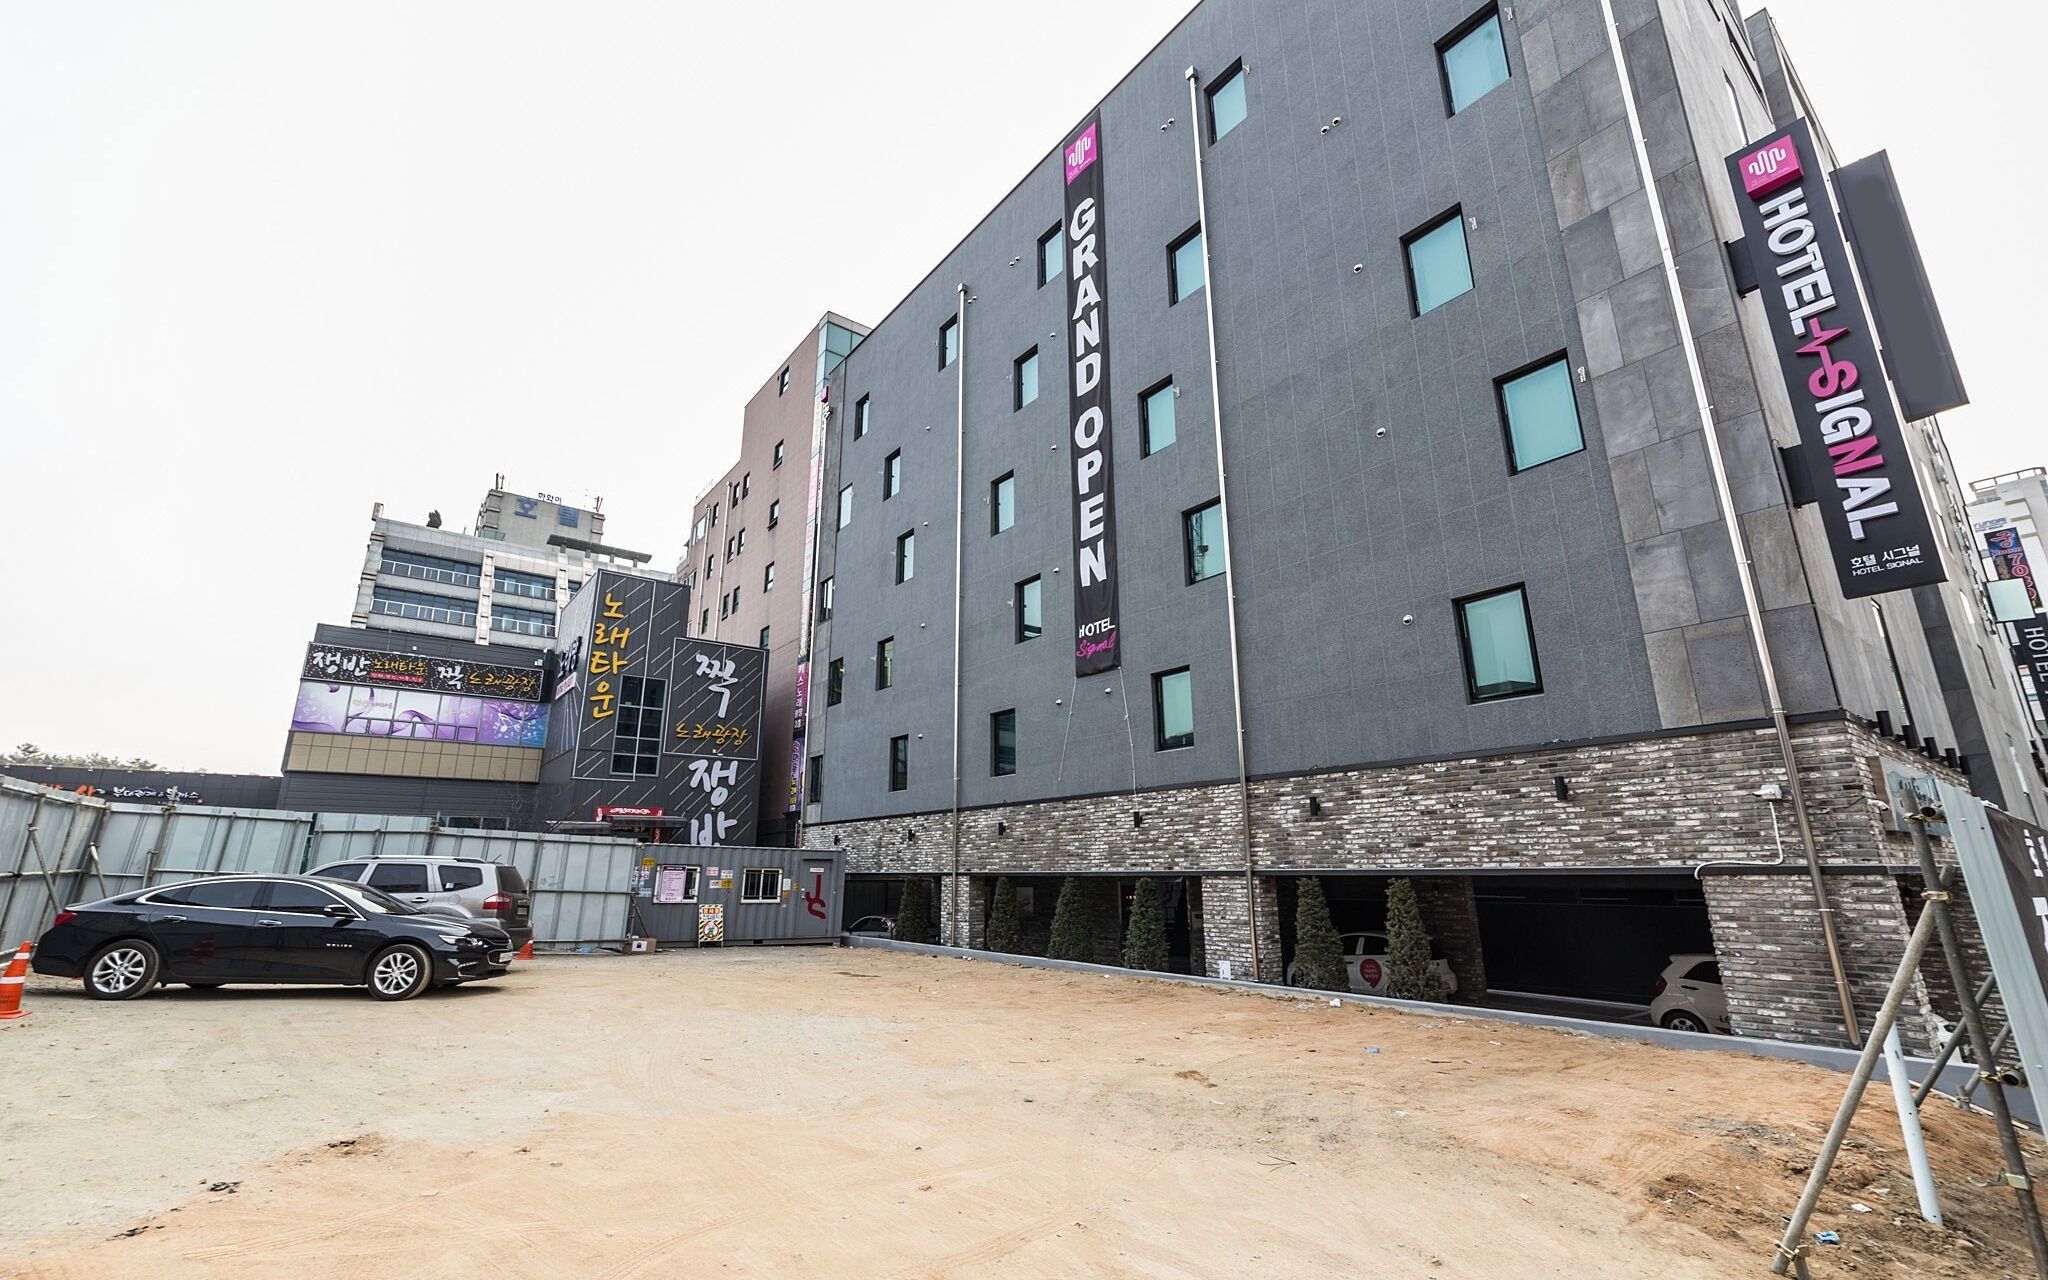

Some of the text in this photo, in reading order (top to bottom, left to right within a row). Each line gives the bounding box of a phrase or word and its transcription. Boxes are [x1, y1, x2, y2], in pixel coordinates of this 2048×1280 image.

[1069, 197, 1101, 398] GRAND
[1759, 186, 1900, 541] HOTEL SIGNAL
[1074, 406, 1107, 587] OPEN
[1850, 544, 1921, 569] 호텔 시그널
[1852, 557, 1924, 577] HOTEL SIGNAL
[1079, 617, 1116, 639] HOTEL
[313, 651, 371, 677] 쟁반
[374, 658, 425, 677] 노래타운
[470, 672, 537, 692] 노래광장
[590, 592, 631, 719] 노래타운
[676, 724, 749, 746] 노래광장
